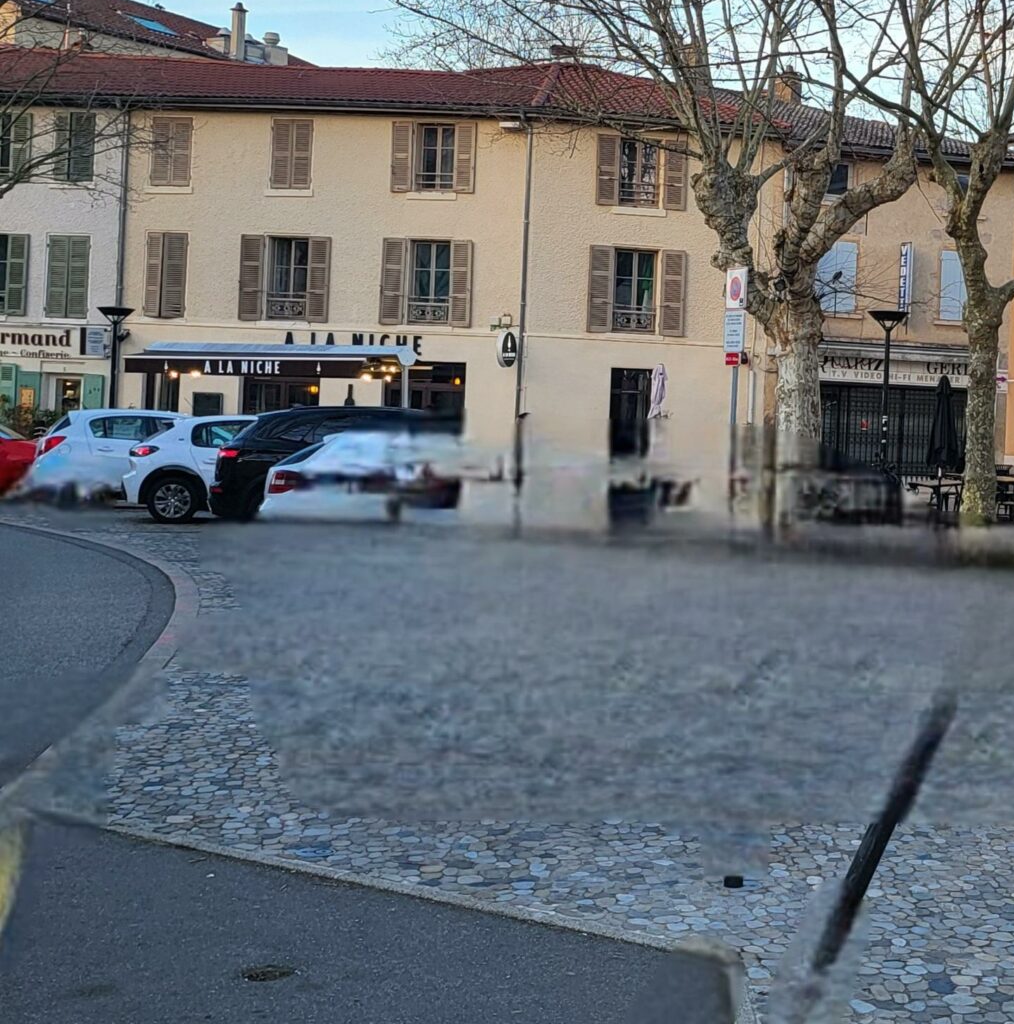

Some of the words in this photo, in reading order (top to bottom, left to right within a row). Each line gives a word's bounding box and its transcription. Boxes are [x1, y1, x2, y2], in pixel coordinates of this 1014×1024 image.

[0, 329, 71, 347] rmand
[352, 333, 422, 356] NICHE
[204, 360, 211, 373] A
[218, 360, 233, 374] LA
[241, 360, 280, 374] NICHE
[854, 372, 882, 380] VIDEO
[916, 375, 961, 384] MENER
